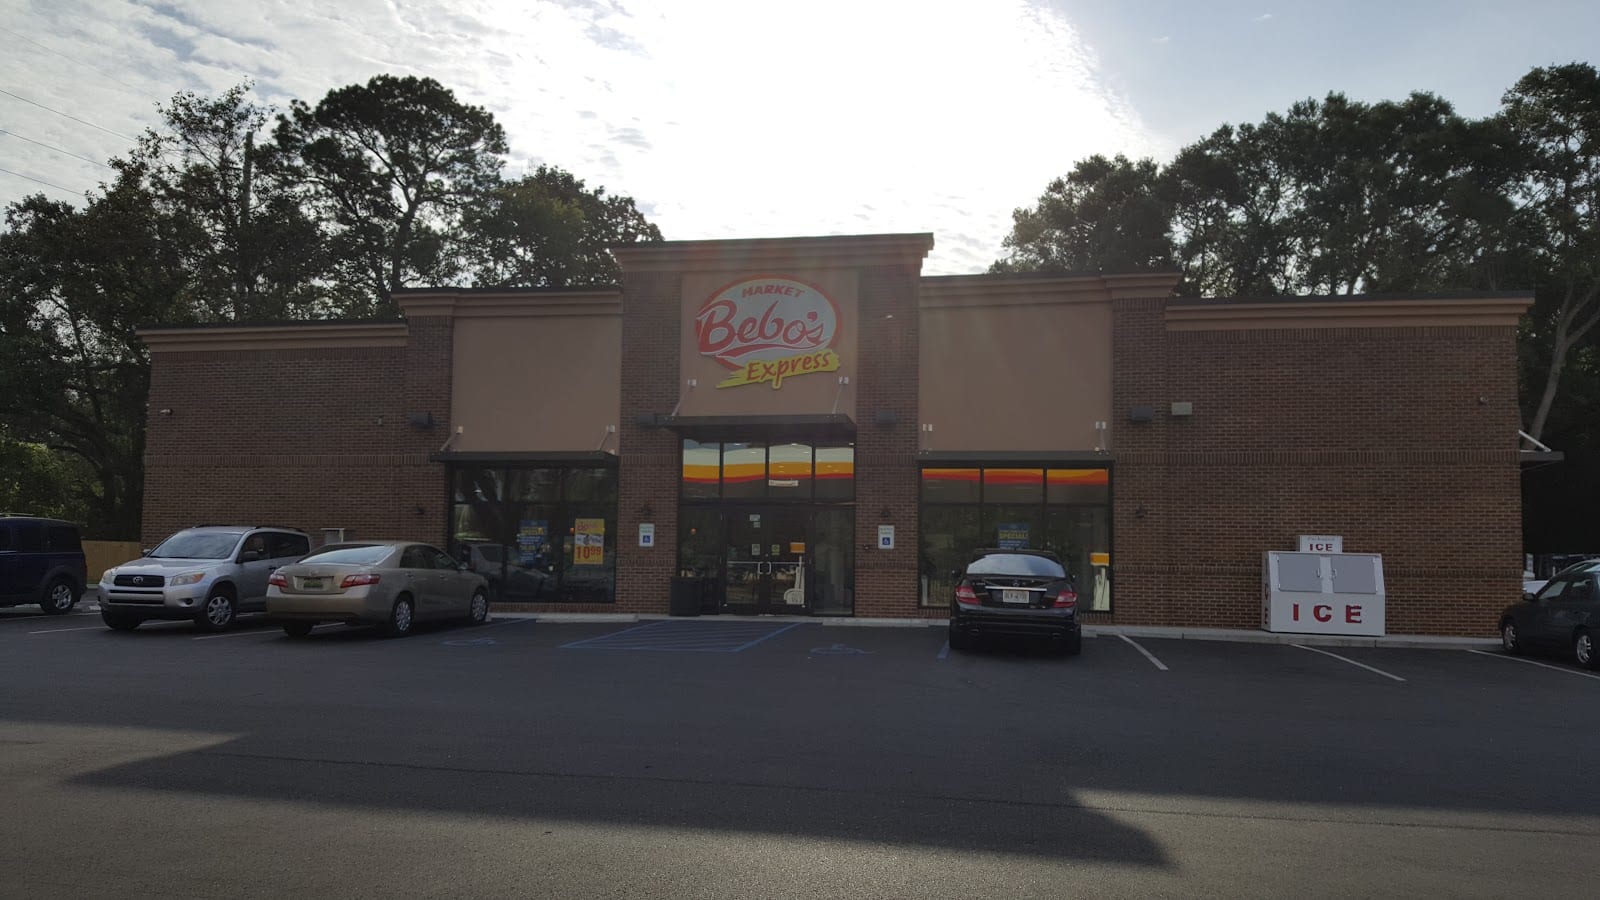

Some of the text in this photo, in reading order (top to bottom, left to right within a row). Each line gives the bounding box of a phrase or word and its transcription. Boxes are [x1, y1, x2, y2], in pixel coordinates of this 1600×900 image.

[741, 284, 806, 298] MARKET
[698, 299, 824, 354] Bebo's
[746, 352, 832, 387] Express
[1309, 543, 1333, 552] ICE
[1292, 603, 1363, 624] ICE
